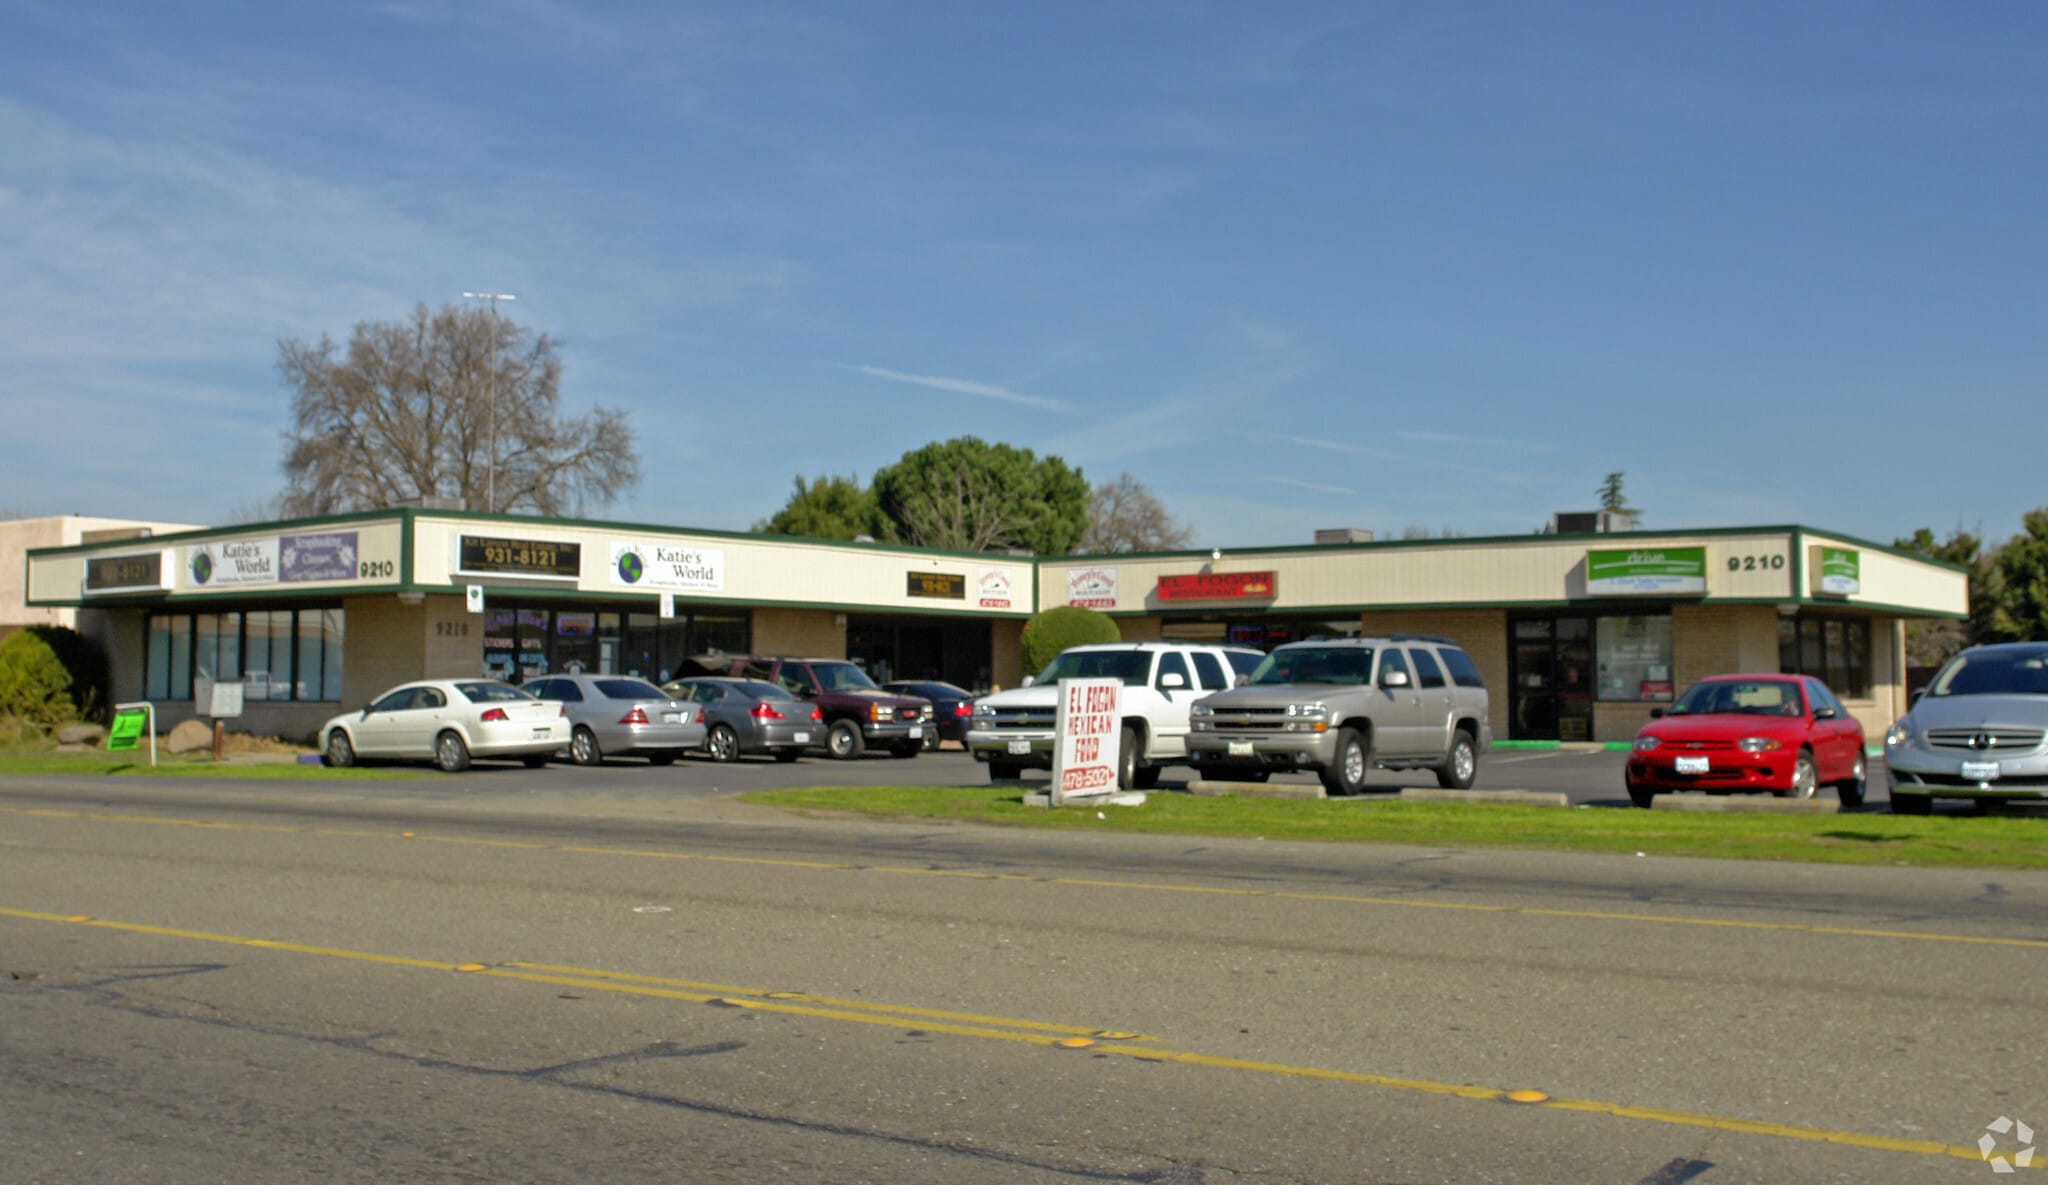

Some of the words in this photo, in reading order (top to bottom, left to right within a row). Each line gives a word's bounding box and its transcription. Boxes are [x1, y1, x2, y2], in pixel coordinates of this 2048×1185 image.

[222, 542, 260, 558] Katie's
[484, 547, 556, 567] 931-8121
[656, 547, 703, 564] Katie's
[234, 557, 270, 573] World
[360, 560, 394, 578] 9210
[1727, 554, 1785, 572] 9210
[672, 564, 715, 581] World
[1069, 687, 1082, 714] EL
[1086, 686, 1117, 714] FOGON
[1068, 715, 1112, 736] MEXICAN
[1074, 737, 1099, 763] FOOD
